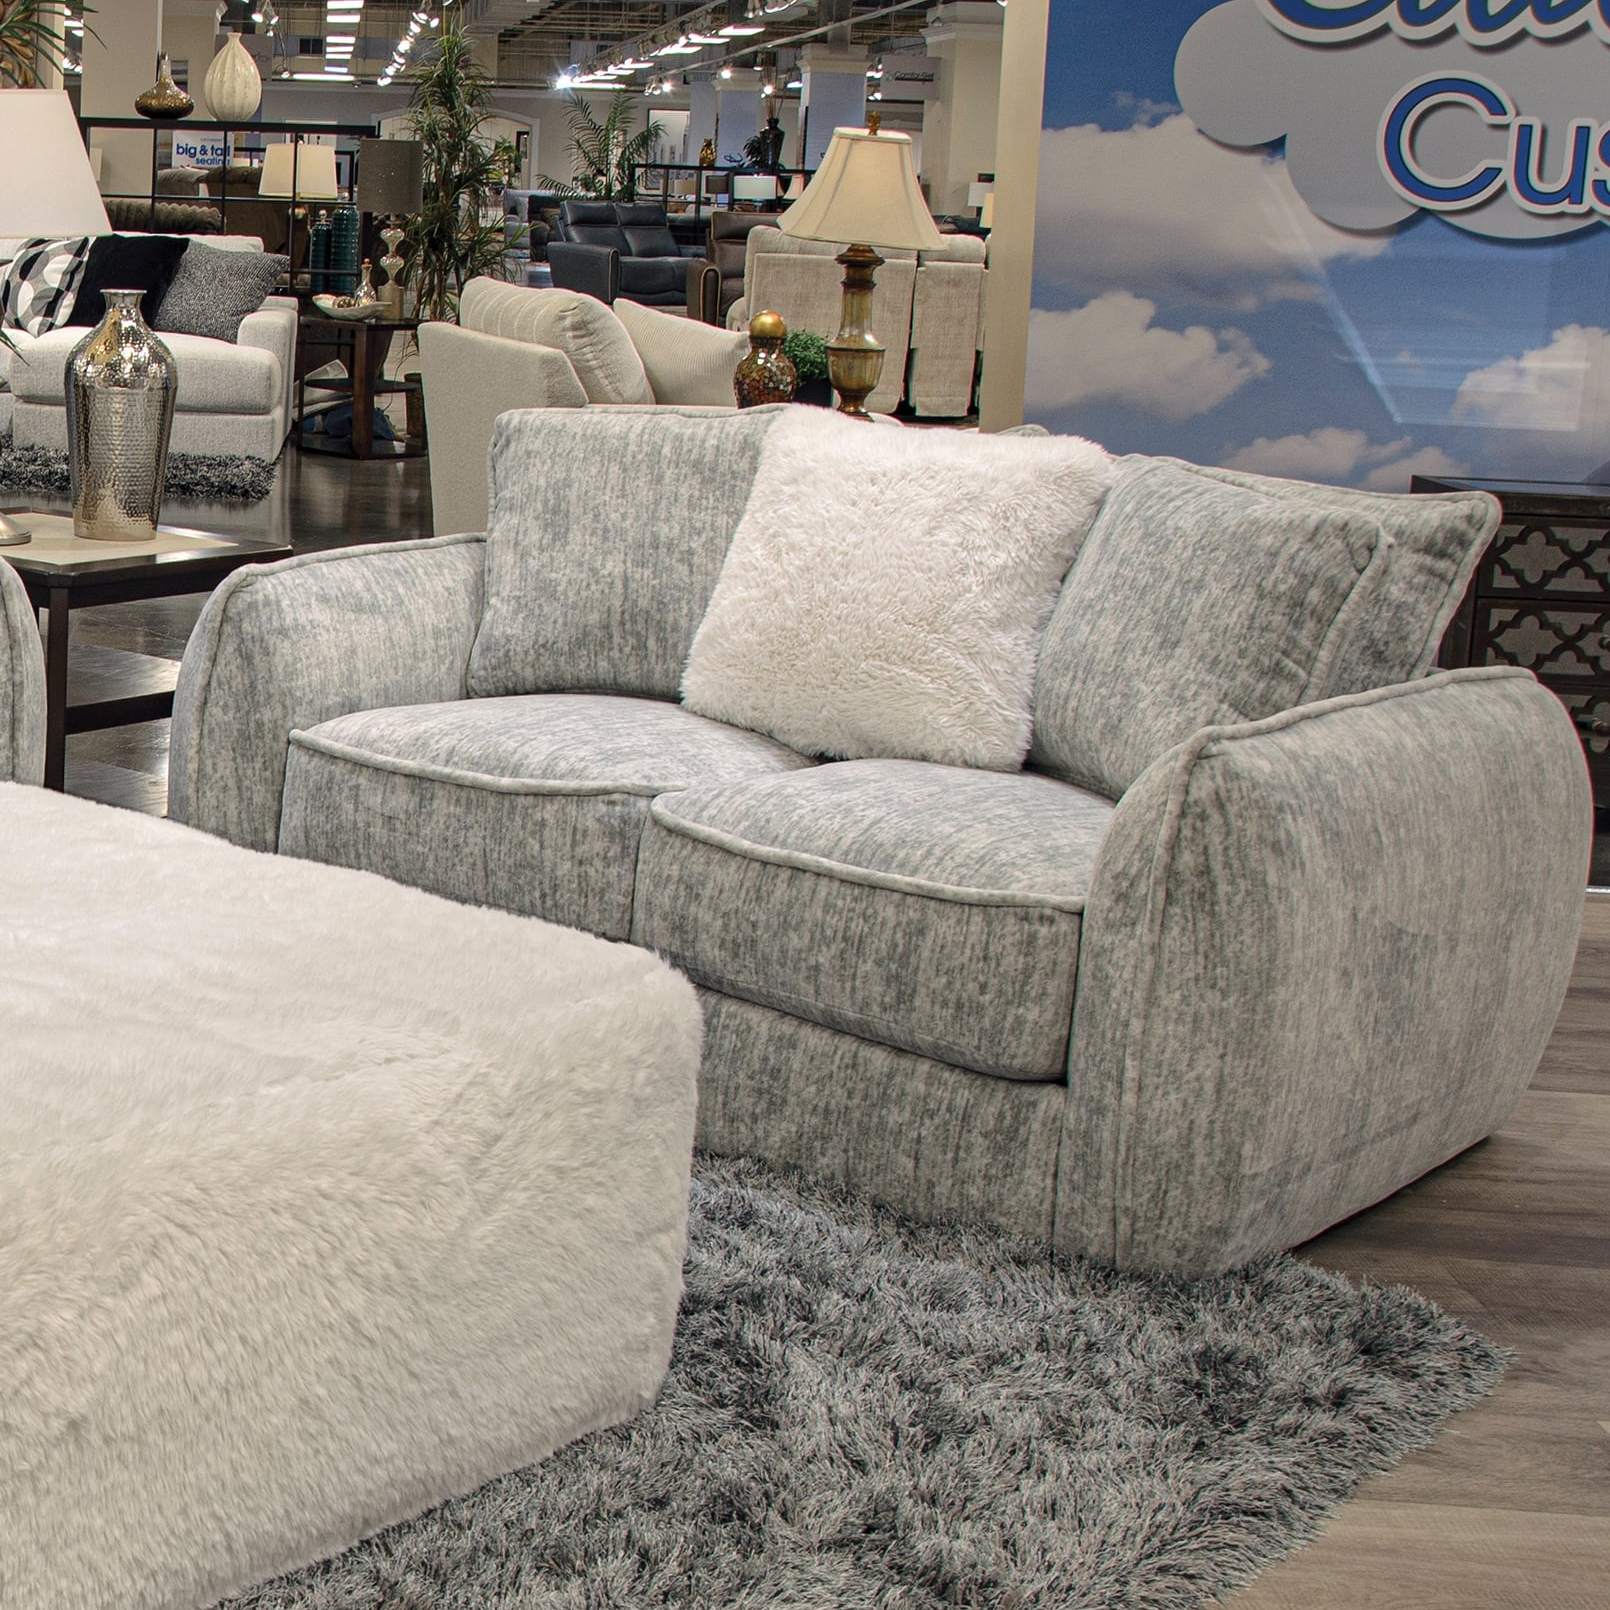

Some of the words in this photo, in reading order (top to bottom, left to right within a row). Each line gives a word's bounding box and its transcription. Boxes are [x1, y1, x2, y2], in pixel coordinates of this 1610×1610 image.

[176, 143, 197, 158] big
[199, 144, 208, 156] &
[211, 145, 230, 157] tal
[195, 156, 230, 165] seatin
